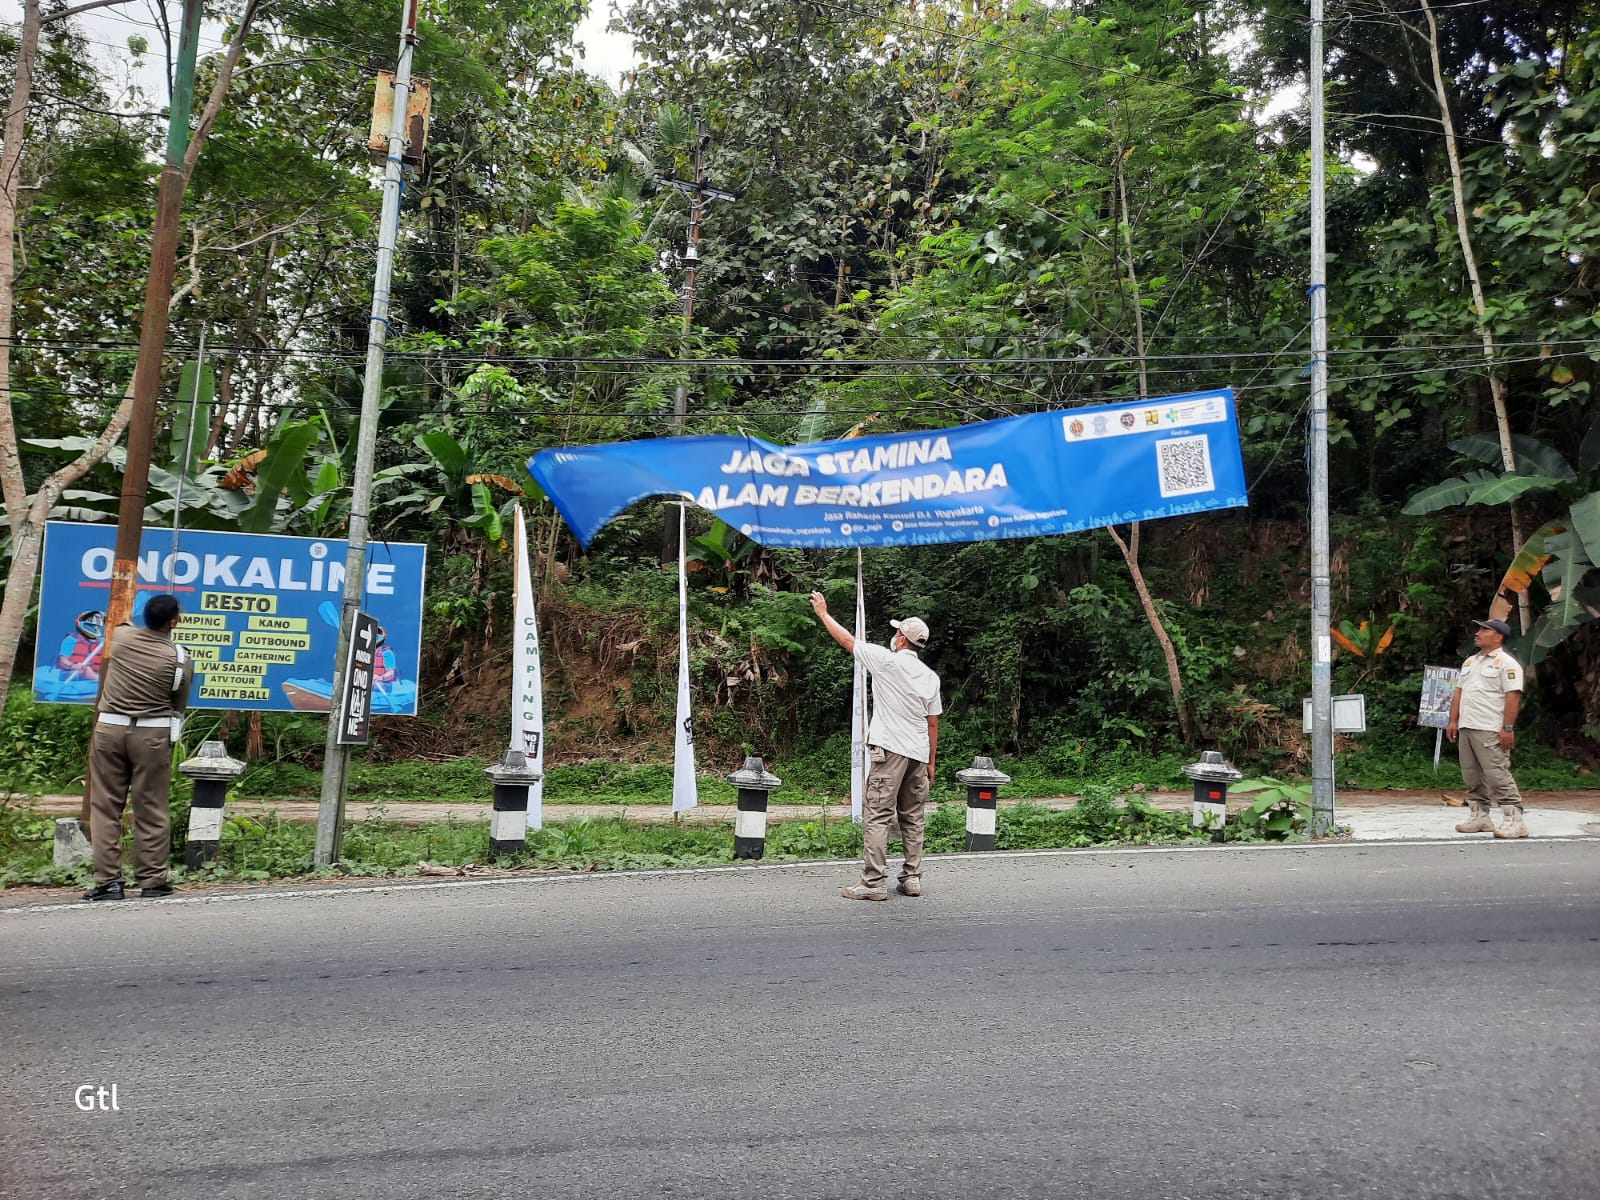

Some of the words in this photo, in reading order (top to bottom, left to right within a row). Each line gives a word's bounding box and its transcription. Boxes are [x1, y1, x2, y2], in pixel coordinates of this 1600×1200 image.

[720, 450, 810, 477] JAGA
[816, 436, 953, 476] STAMINA
[794, 463, 1009, 508] BERKENDARA
[935, 505, 985, 517] Yogyakarta
[204, 594, 271, 612] RESTO
[178, 615, 221, 627] AMPING
[259, 618, 290, 629] KANO
[173, 632, 199, 642] JEEP
[201, 633, 231, 643] TOUR
[245, 636, 306, 648] OUTBOUND
[237, 651, 291, 662] GATHERING
[201, 662, 220, 671] VW
[222, 663, 263, 674] SAFARI
[522, 617, 538, 721] CAMPING
[210, 675, 228, 683] ATV
[230, 676, 255, 685] TOUR
[200, 688, 238, 698] PAINT
[239, 689, 268, 700] BALL
